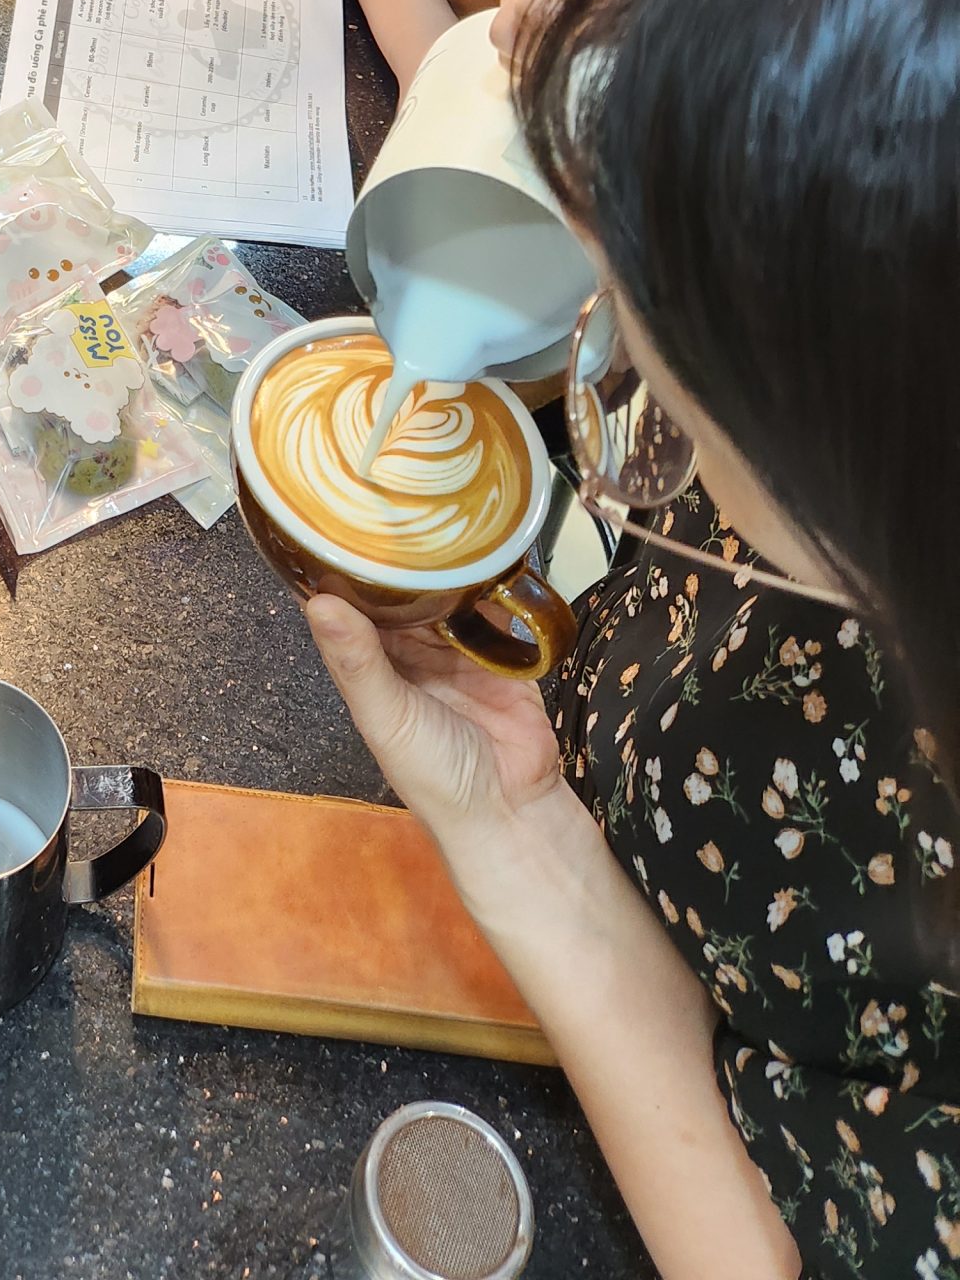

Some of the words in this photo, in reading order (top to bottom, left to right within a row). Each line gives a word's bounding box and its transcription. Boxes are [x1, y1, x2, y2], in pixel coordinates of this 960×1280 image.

[37, 9, 47, 27] phê
[34, 29, 44, 41] Cà
[31, 43, 44, 68] uống
[99, 315, 124, 353] YOU
